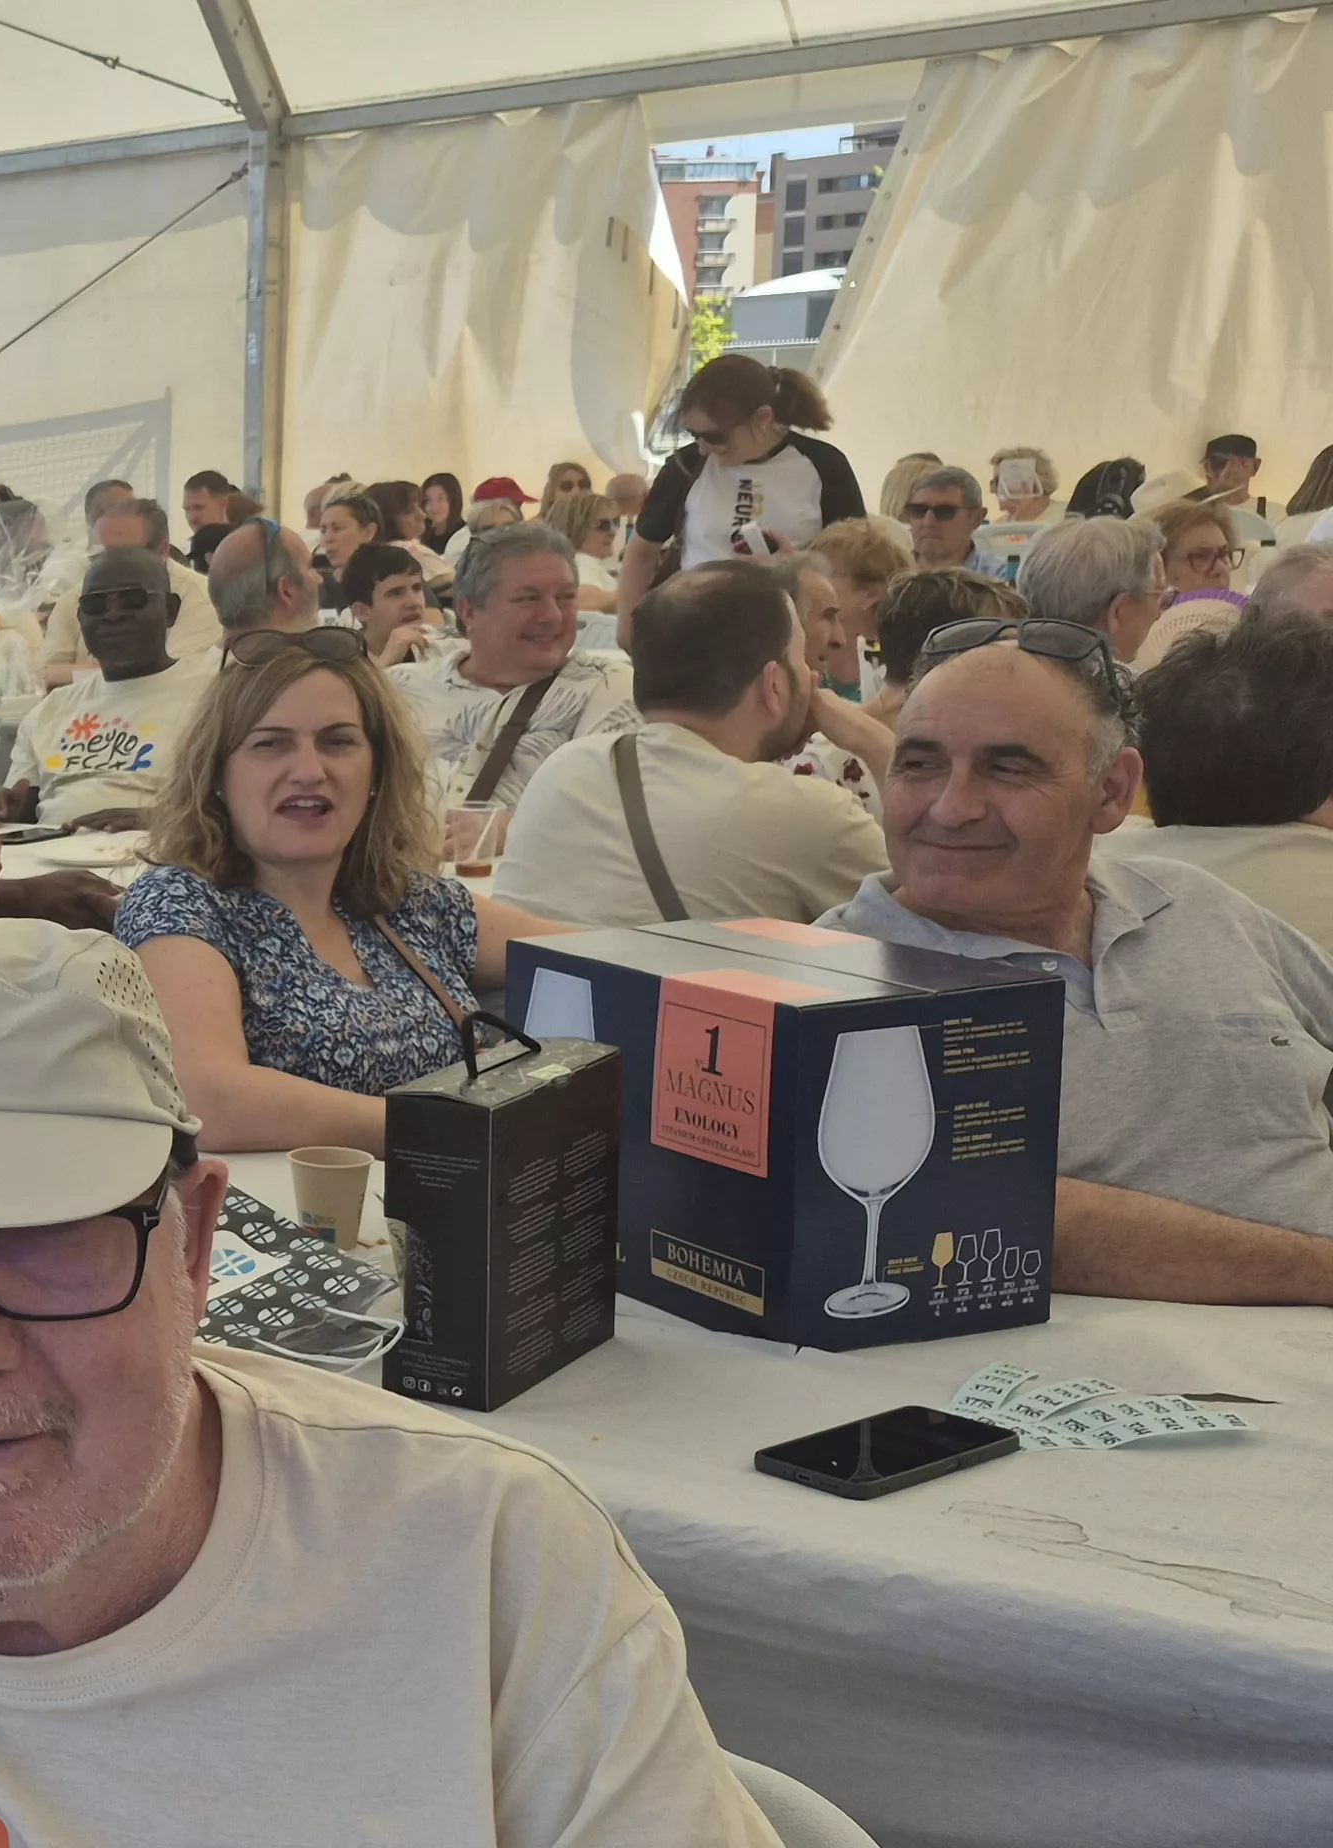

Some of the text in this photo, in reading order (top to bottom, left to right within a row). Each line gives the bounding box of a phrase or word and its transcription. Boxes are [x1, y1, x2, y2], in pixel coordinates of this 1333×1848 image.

[665, 1068, 756, 1116] MAGNUS
[674, 1106, 741, 1141] ENOLOGY
[666, 1242, 746, 1287] BOHEMIA
[666, 1268, 746, 1307] CZECH REPUBLIC
